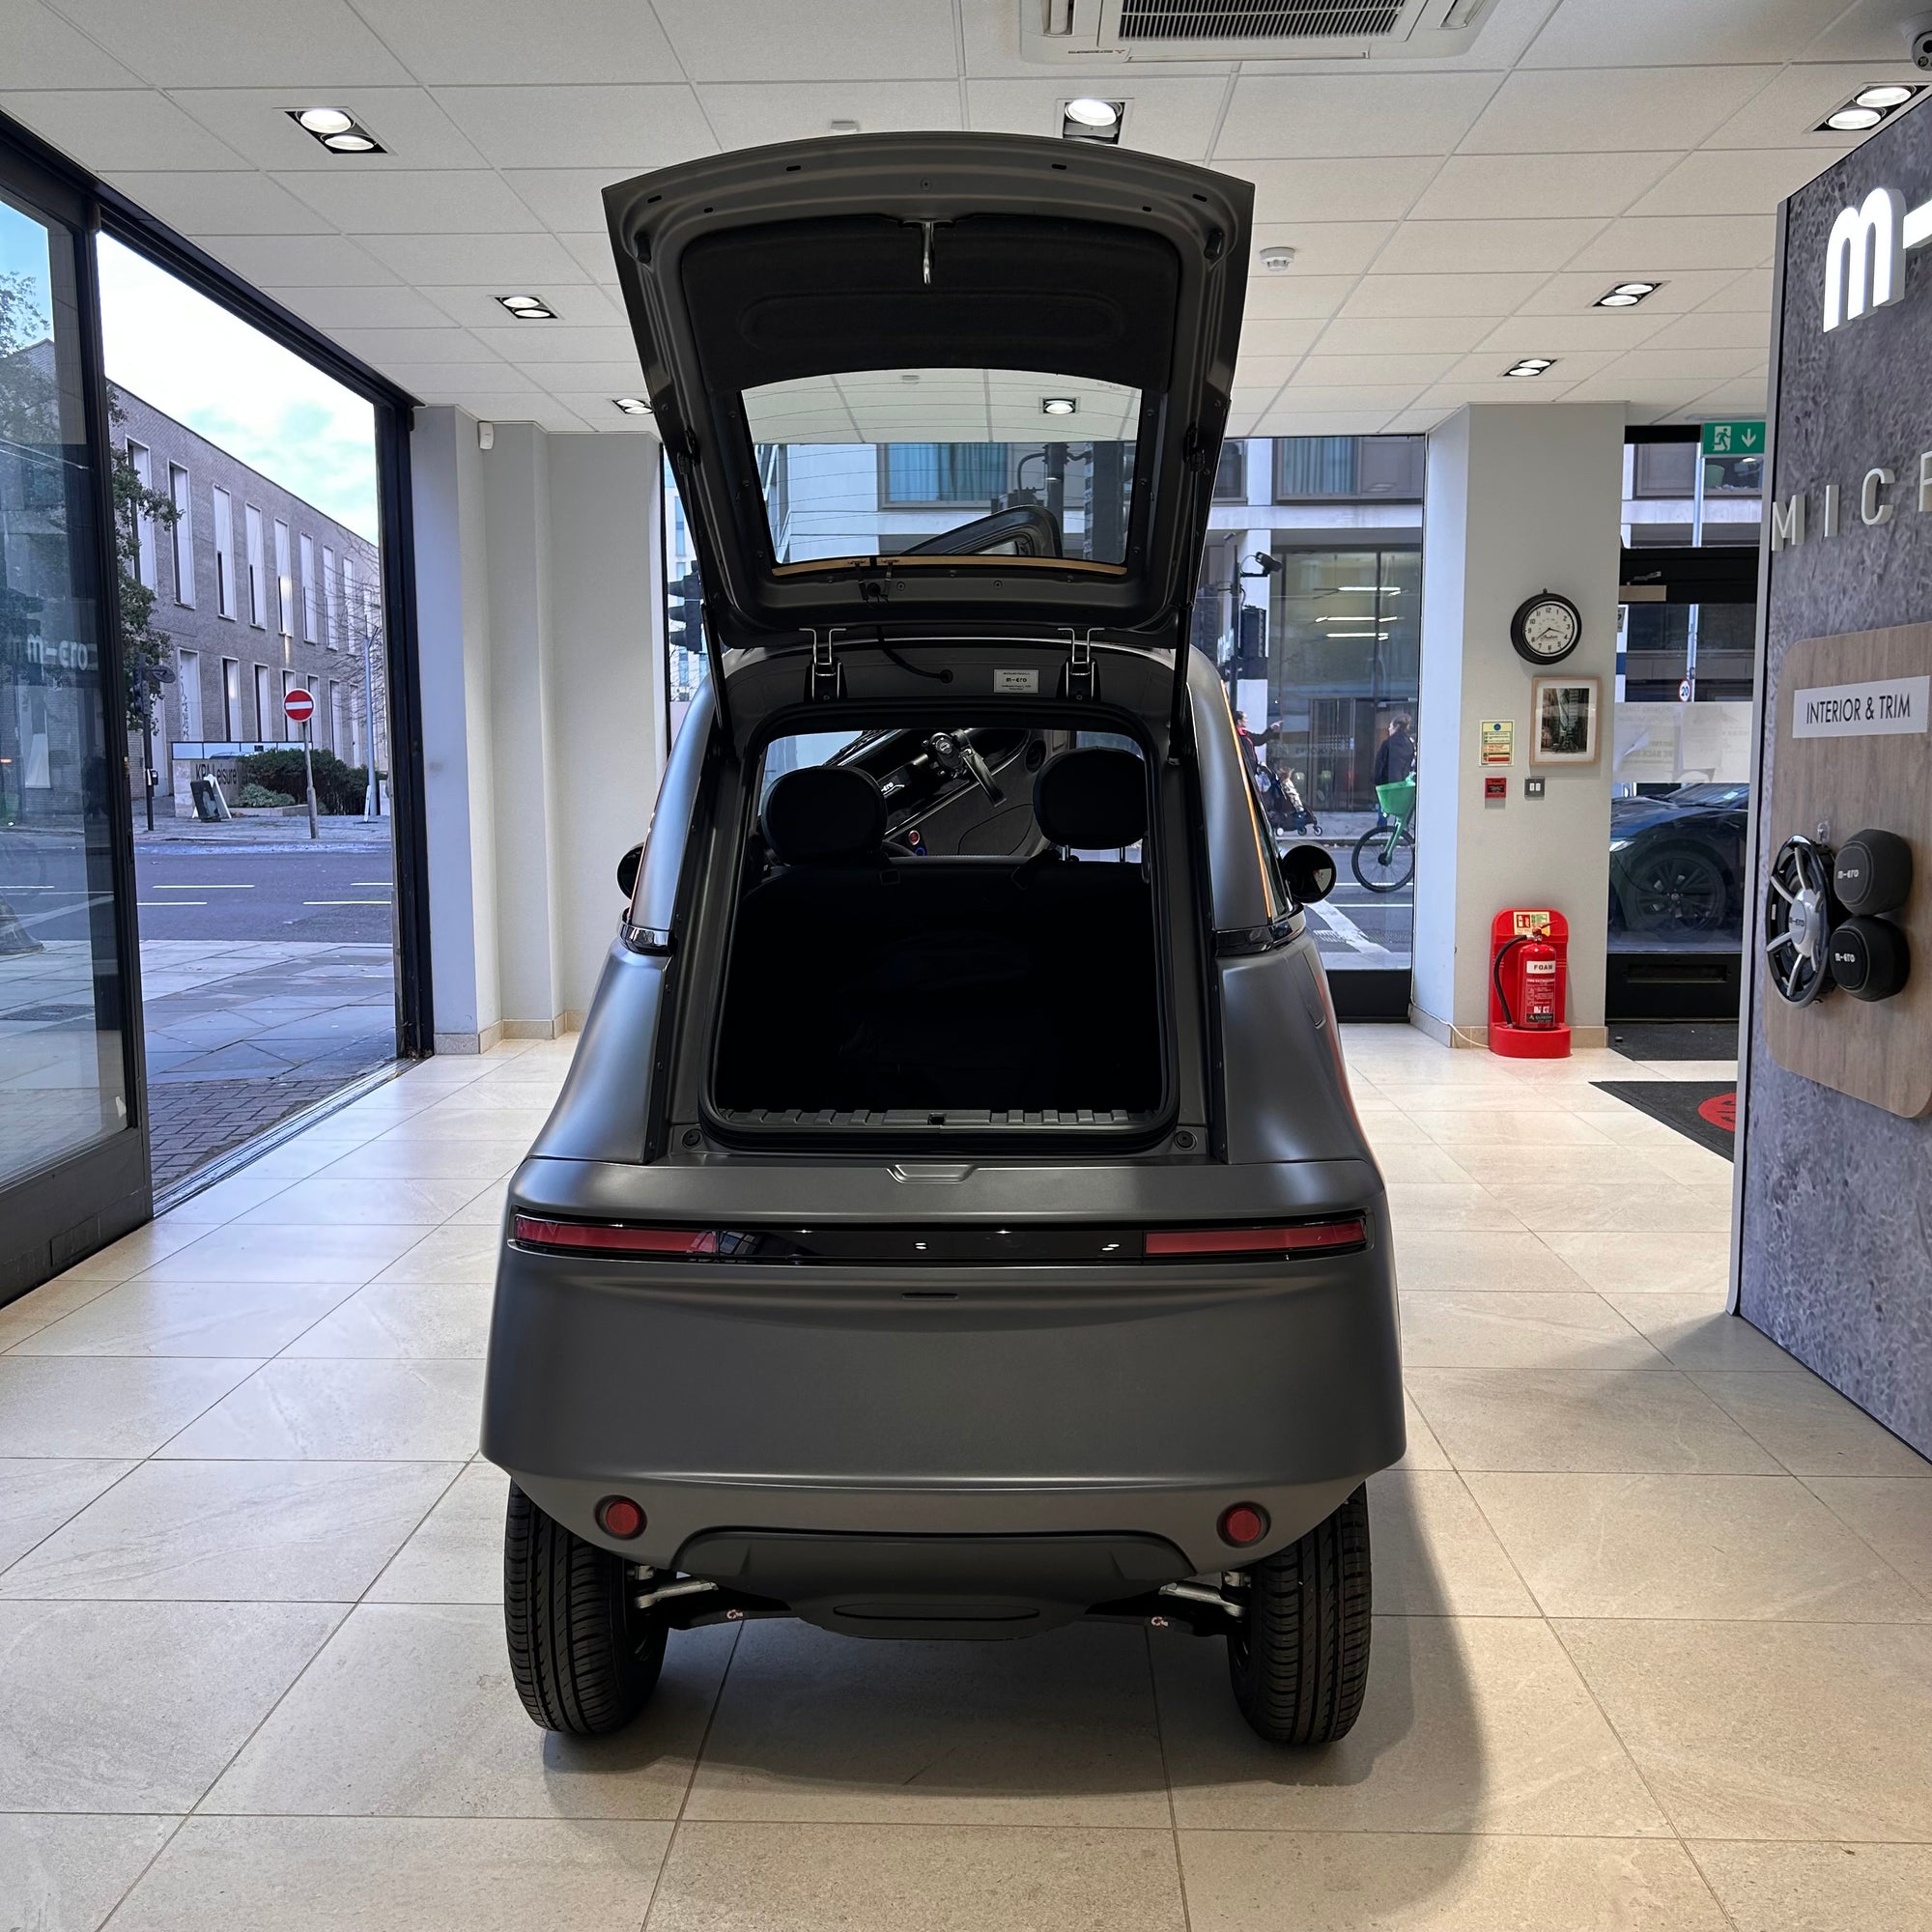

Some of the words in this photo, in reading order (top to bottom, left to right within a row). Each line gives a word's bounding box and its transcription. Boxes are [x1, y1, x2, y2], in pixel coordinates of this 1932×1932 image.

[1806, 697, 1861, 724] INTERIOR
[1865, 696, 1875, 721] &
[1879, 694, 1911, 720] TRIM
